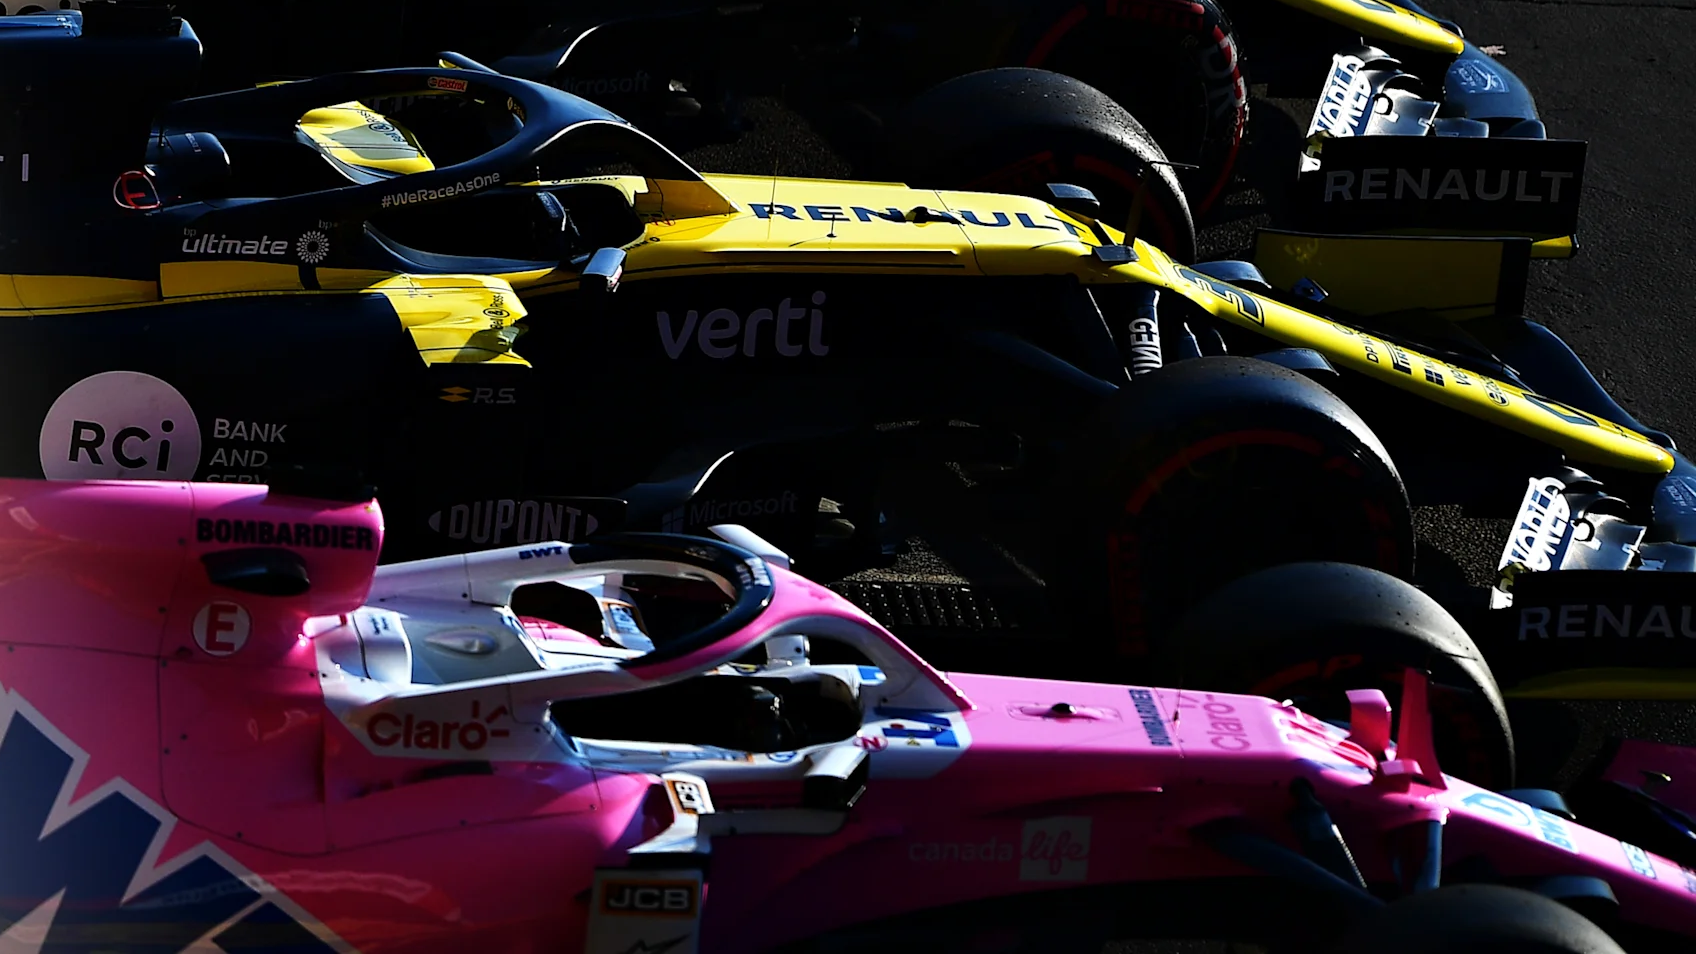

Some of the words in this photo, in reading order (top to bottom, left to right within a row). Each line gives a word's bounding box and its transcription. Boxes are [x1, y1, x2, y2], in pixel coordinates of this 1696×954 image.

[437, 78, 466, 91] Castrol
[381, 171, 501, 209] #WeRaceAsOne
[1324, 168, 1574, 203] RENAULT
[182, 234, 289, 255] ultimate
[656, 289, 831, 360] verti
[68, 419, 175, 472] RCi
[213, 417, 289, 444] BANK
[209, 448, 270, 469] AND
[447, 498, 583, 545] DUPONT
[690, 489, 799, 527] Microsoft
[195, 516, 374, 550] BOMBARDIER
[518, 545, 563, 561] BWT
[365, 710, 491, 752] Claro
[1205, 699, 1252, 751] Claro
[909, 836, 1013, 864] canada
[1021, 830, 1088, 876] life
[608, 888, 689, 909] JCB
